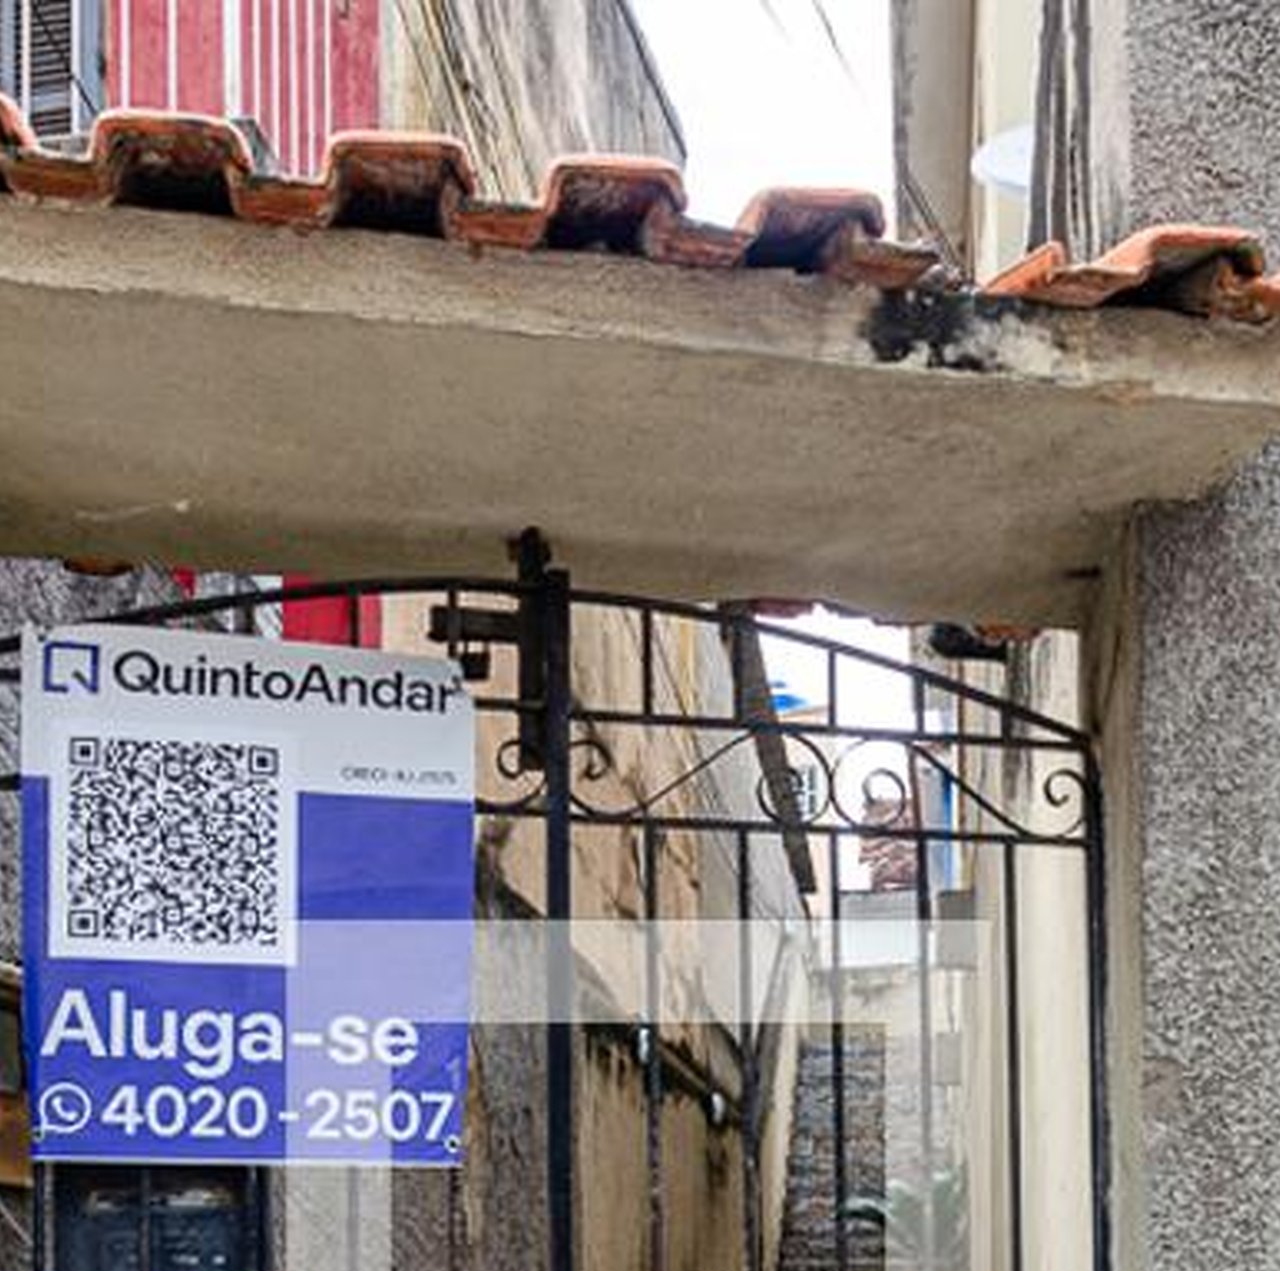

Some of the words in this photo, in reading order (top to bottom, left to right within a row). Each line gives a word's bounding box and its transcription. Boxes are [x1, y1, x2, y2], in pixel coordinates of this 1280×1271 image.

[113, 650, 456, 715] QuintoAndar
[40, 988, 419, 1079] Aluga-se
[101, 1084, 455, 1142] 4020-2507
